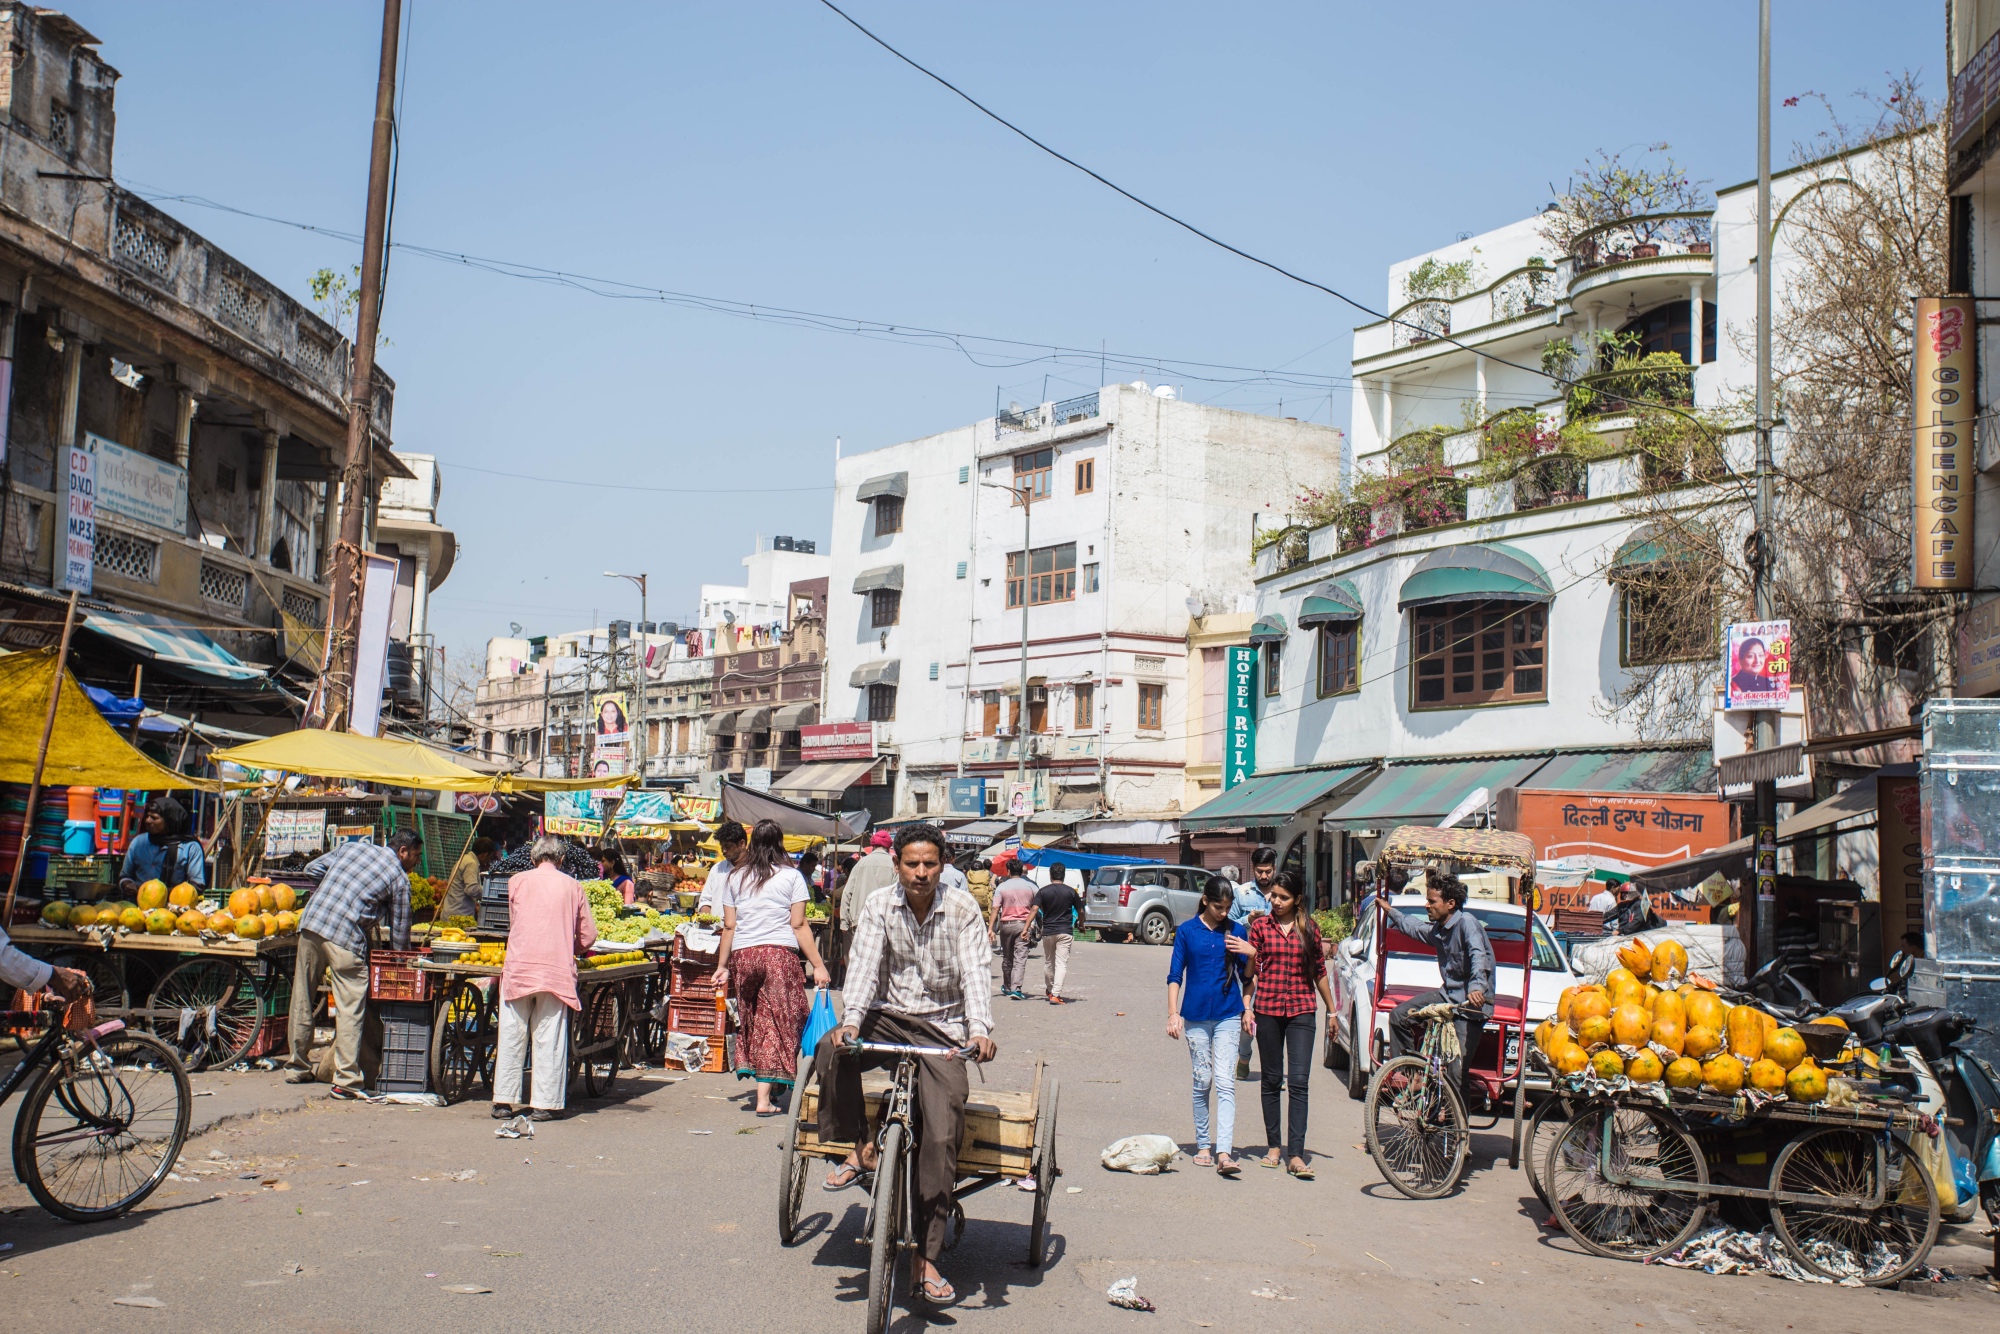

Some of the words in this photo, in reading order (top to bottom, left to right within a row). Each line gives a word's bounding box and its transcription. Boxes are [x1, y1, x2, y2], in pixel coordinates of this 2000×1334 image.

[68, 538, 93, 560] REMOTE
[1236, 651, 1250, 708] HOTEL
[1233, 716, 1248, 788] RELA
[1562, 804, 1610, 827] दिल्ली
[1613, 809, 1647, 832] दुग्ध
[1651, 806, 1704, 832] योजना
[1550, 893, 1590, 907] DELH
